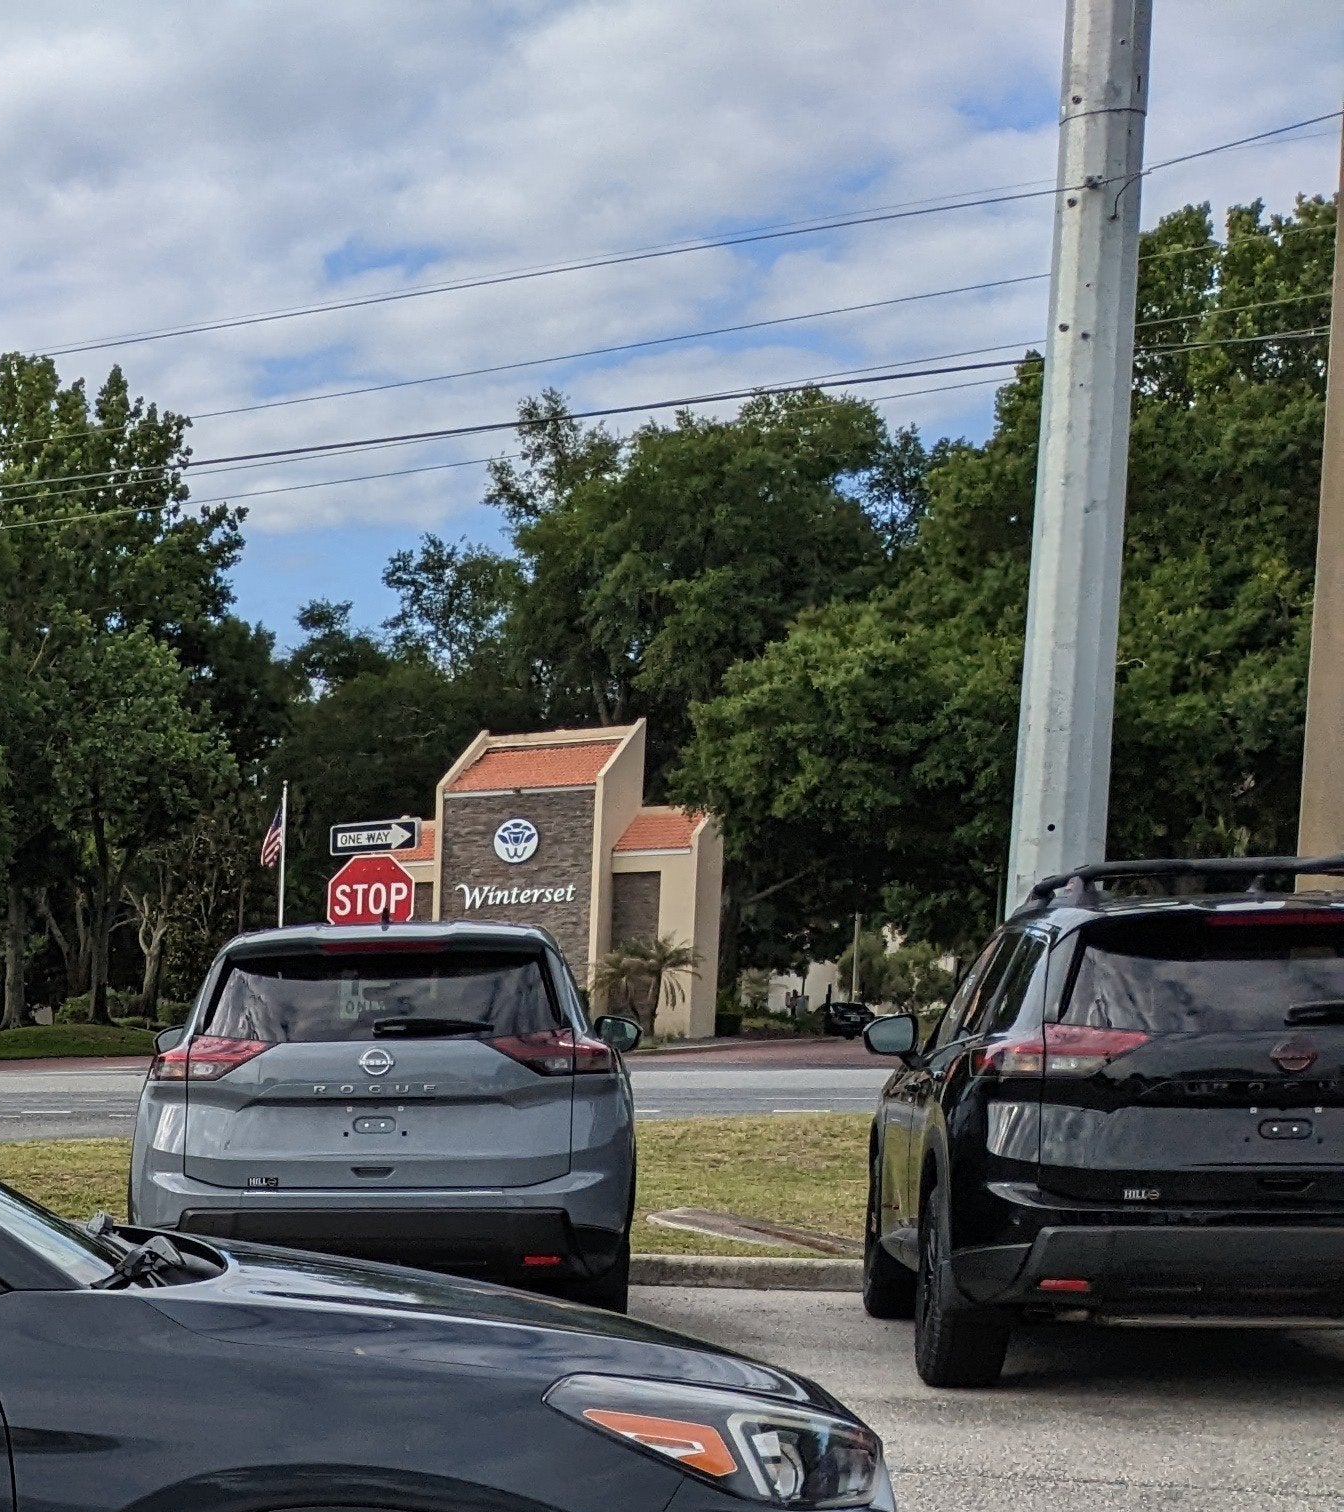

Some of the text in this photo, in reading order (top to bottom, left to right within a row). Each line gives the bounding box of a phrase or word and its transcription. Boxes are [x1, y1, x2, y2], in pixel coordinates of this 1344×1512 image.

[340, 831, 391, 846] ONE WAY
[334, 882, 408, 916] STOP
[454, 883, 577, 910] Winterset
[313, 1084, 438, 1095] ROGUE
[1123, 1189, 1148, 1200] HILL
